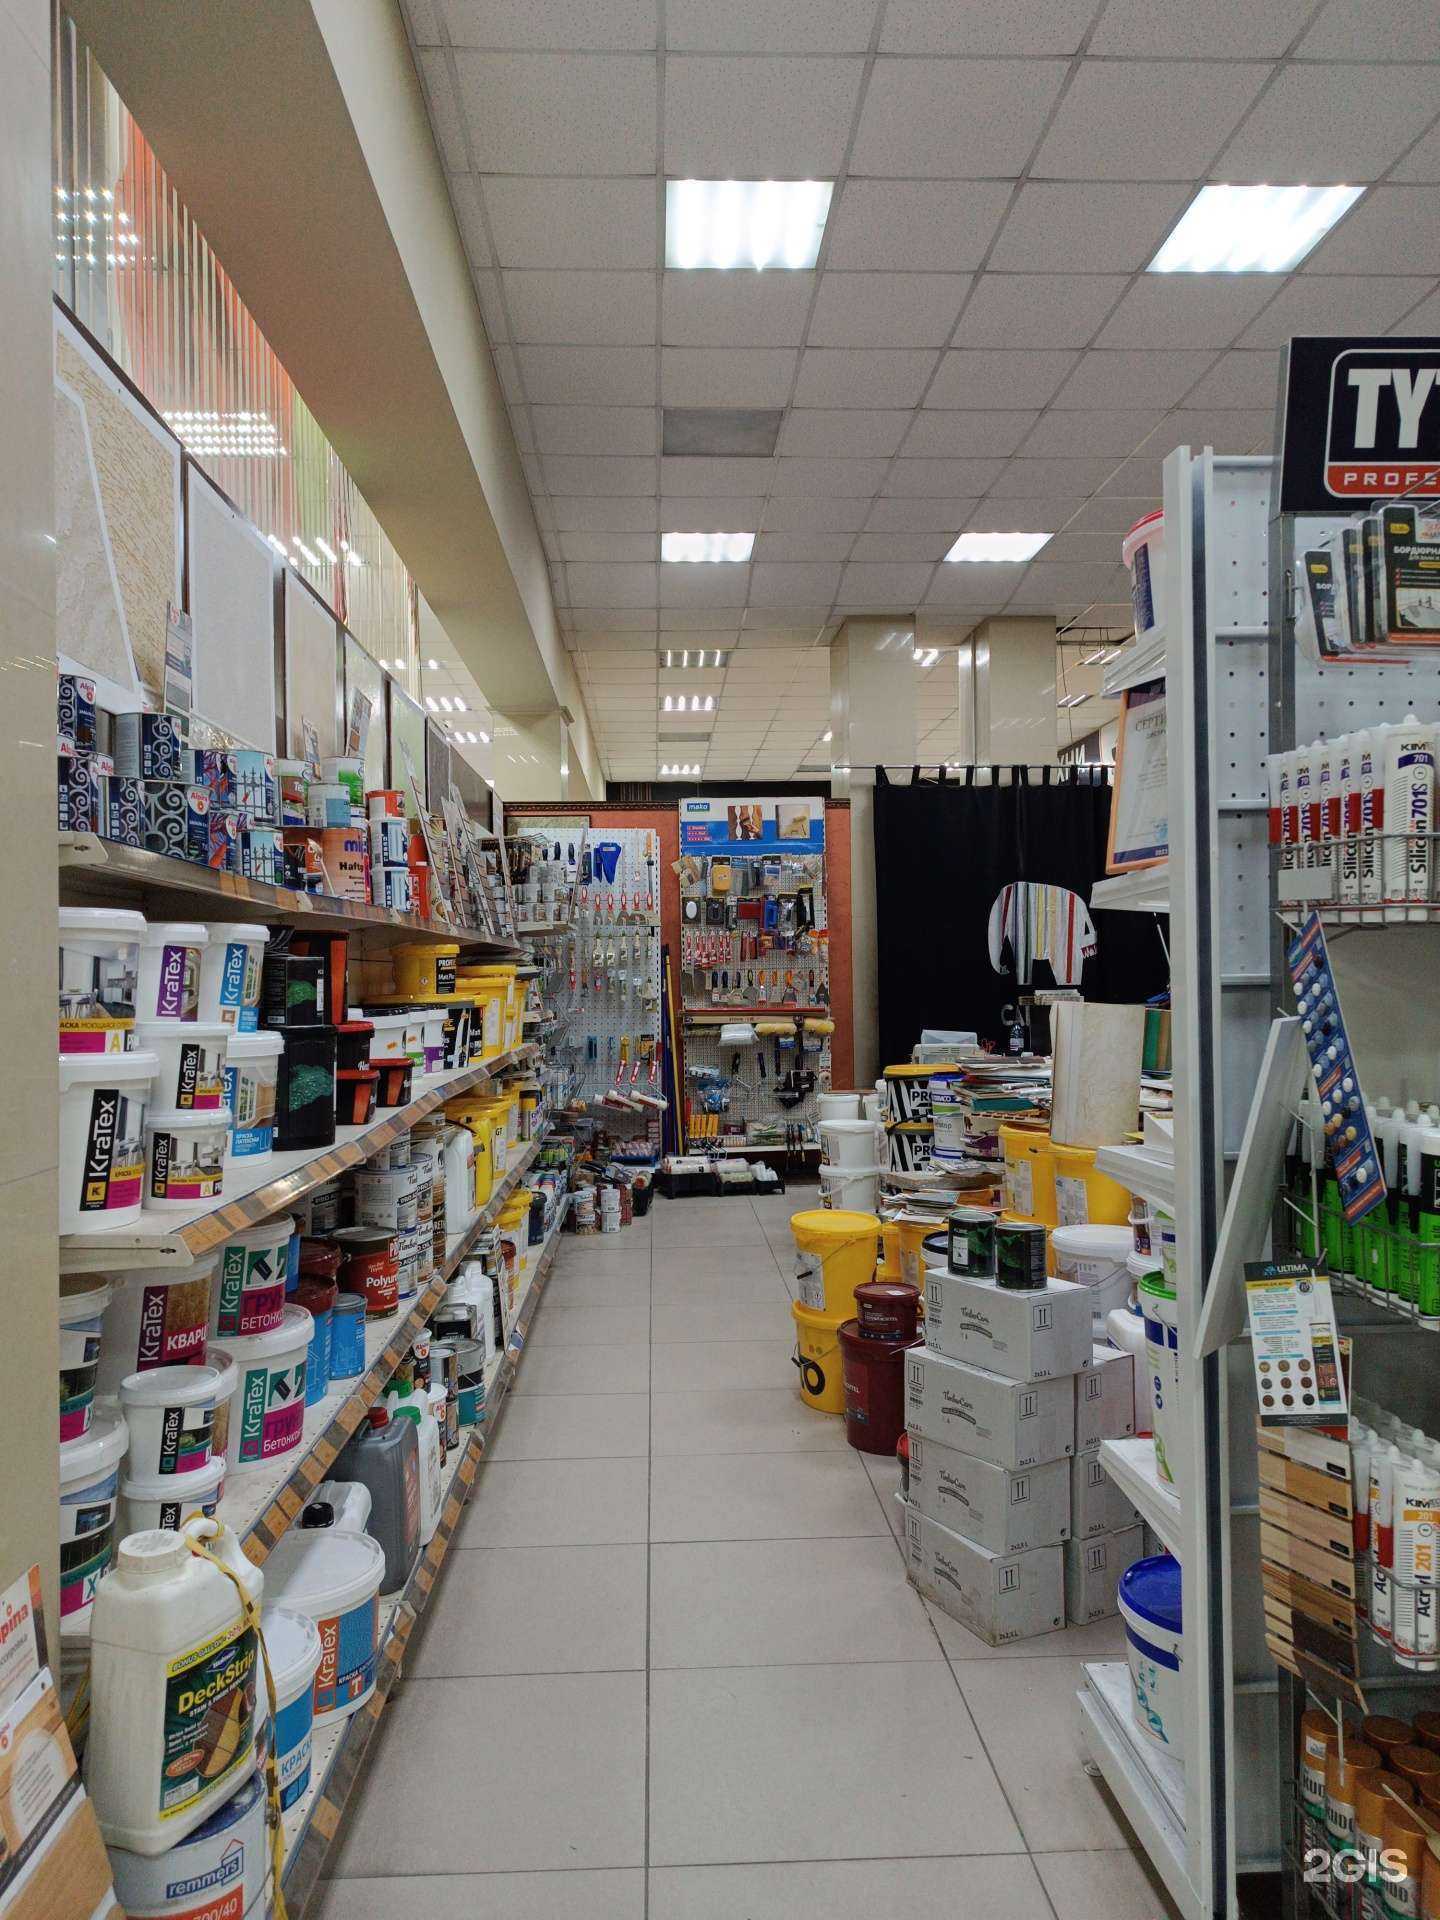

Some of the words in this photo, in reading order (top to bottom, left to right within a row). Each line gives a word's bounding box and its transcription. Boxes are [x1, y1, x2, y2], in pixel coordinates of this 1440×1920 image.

[1348, 368, 1440, 449] TY
[1413, 754, 1428, 763] 701
[1411, 783, 1428, 819] 701S
[89, 1098, 115, 1177] KraTex
[153, 1138, 168, 1181] KraTex
[220, 1251, 243, 1314] KraTex
[1276, 1263, 1309, 1273] ULTIMA
[139, 1292, 165, 1362] KraTex
[244, 1375, 265, 1437] KraTex
[163, 1410, 179, 1456] KraTex
[1414, 1544, 1432, 1572] 201
[178, 1648, 255, 1715] DeckStrip
[168, 1859, 239, 1897] remmers
